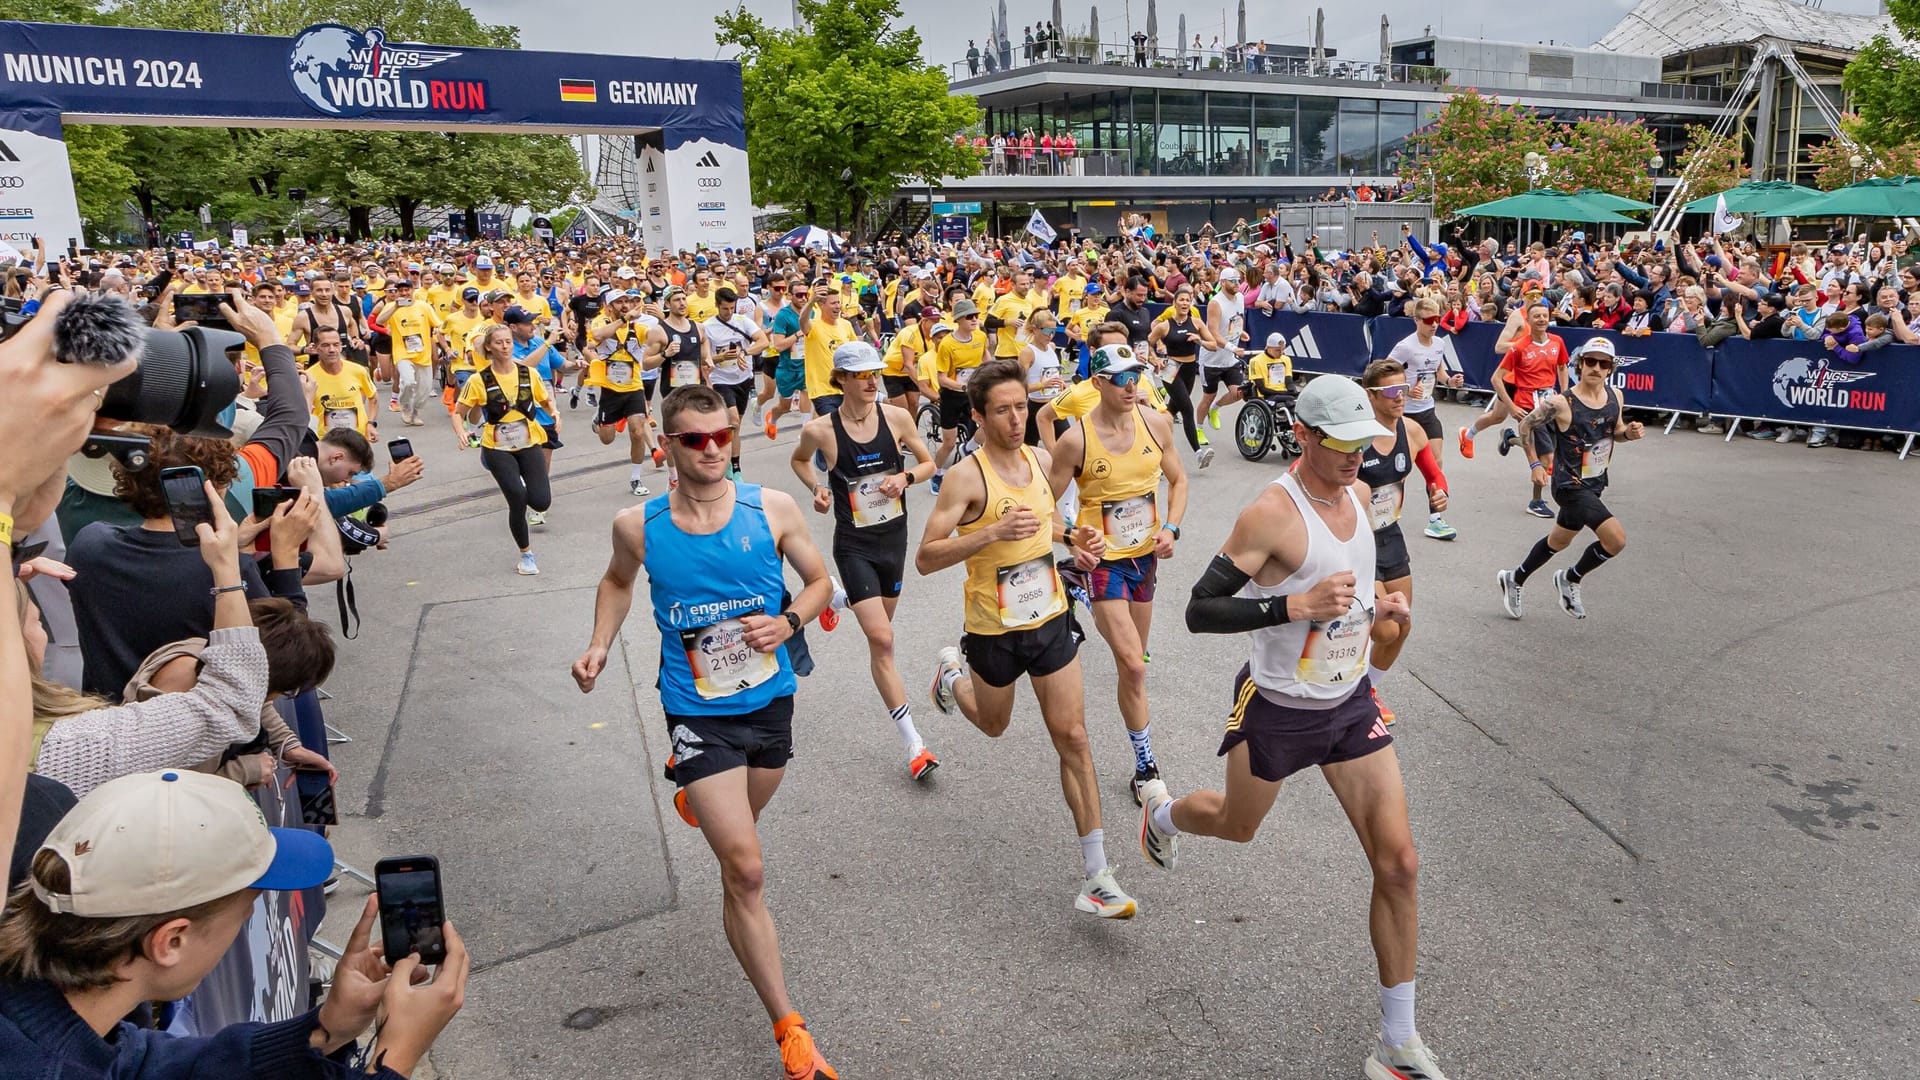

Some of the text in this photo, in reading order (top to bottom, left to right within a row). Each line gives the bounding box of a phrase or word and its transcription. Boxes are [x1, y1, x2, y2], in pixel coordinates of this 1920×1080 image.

[351, 49, 420, 66] WINGS
[4, 53, 203, 88] MUNICH 2024
[348, 63, 364, 71] FOR
[363, 63, 400, 78] LIFE
[326, 76, 486, 110] WORLD RUN
[608, 80, 698, 105] GERMANY
[0, 208, 33, 216] ESER
[0, 232, 37, 241] IACTIV
[1627, 373, 1654, 392] RUN
[1807, 370, 1848, 381] WINGS
[1812, 380, 1834, 389] LIFE
[1790, 386, 1886, 411] WORLD RUN
[1017, 588, 1044, 604] 29585
[690, 595, 765, 615] engelhorn
[691, 613, 728, 625] SPORTS
[710, 646, 753, 671] 21967
[1327, 646, 1357, 661] 31318
